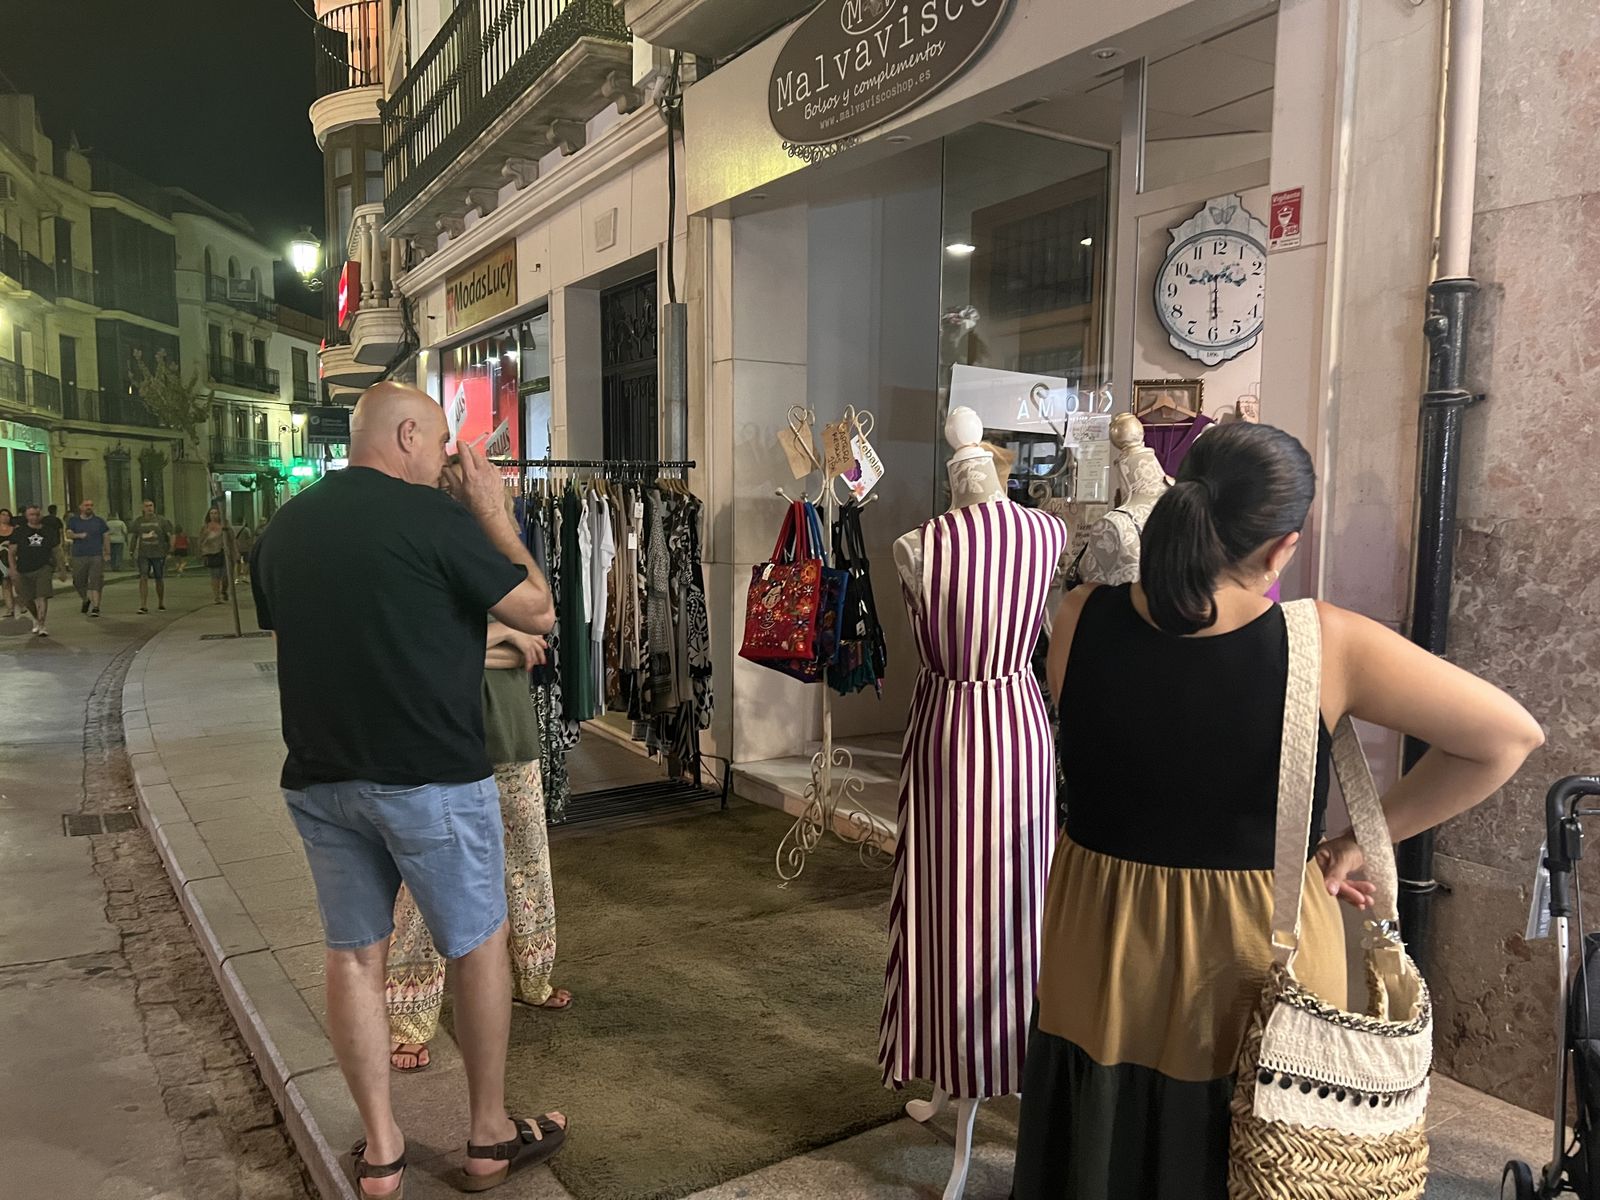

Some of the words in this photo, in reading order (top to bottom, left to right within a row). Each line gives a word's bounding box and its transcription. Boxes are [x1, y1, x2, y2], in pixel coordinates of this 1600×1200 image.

[776, 0, 988, 112] Malvavisc
[804, 95, 840, 120] Bolsos
[842, 88, 850, 106] y
[853, 40, 946, 96] complementos
[820, 69, 931, 129] www.malvaviscoshop.es
[1194, 246, 1202, 260] 11
[1213, 242, 1228, 255] 12
[1239, 246, 1244, 259] 1
[1175, 262, 1188, 276] 10
[1251, 262, 1262, 275] 2
[455, 259, 513, 312] ModasLucy
[1167, 283, 1178, 298] 9
[1171, 305, 1183, 318] 8
[1247, 304, 1258, 318] 4
[1188, 320, 1197, 335] 7
[1208, 327, 1218, 341] 6
[1230, 320, 1241, 334] 5
